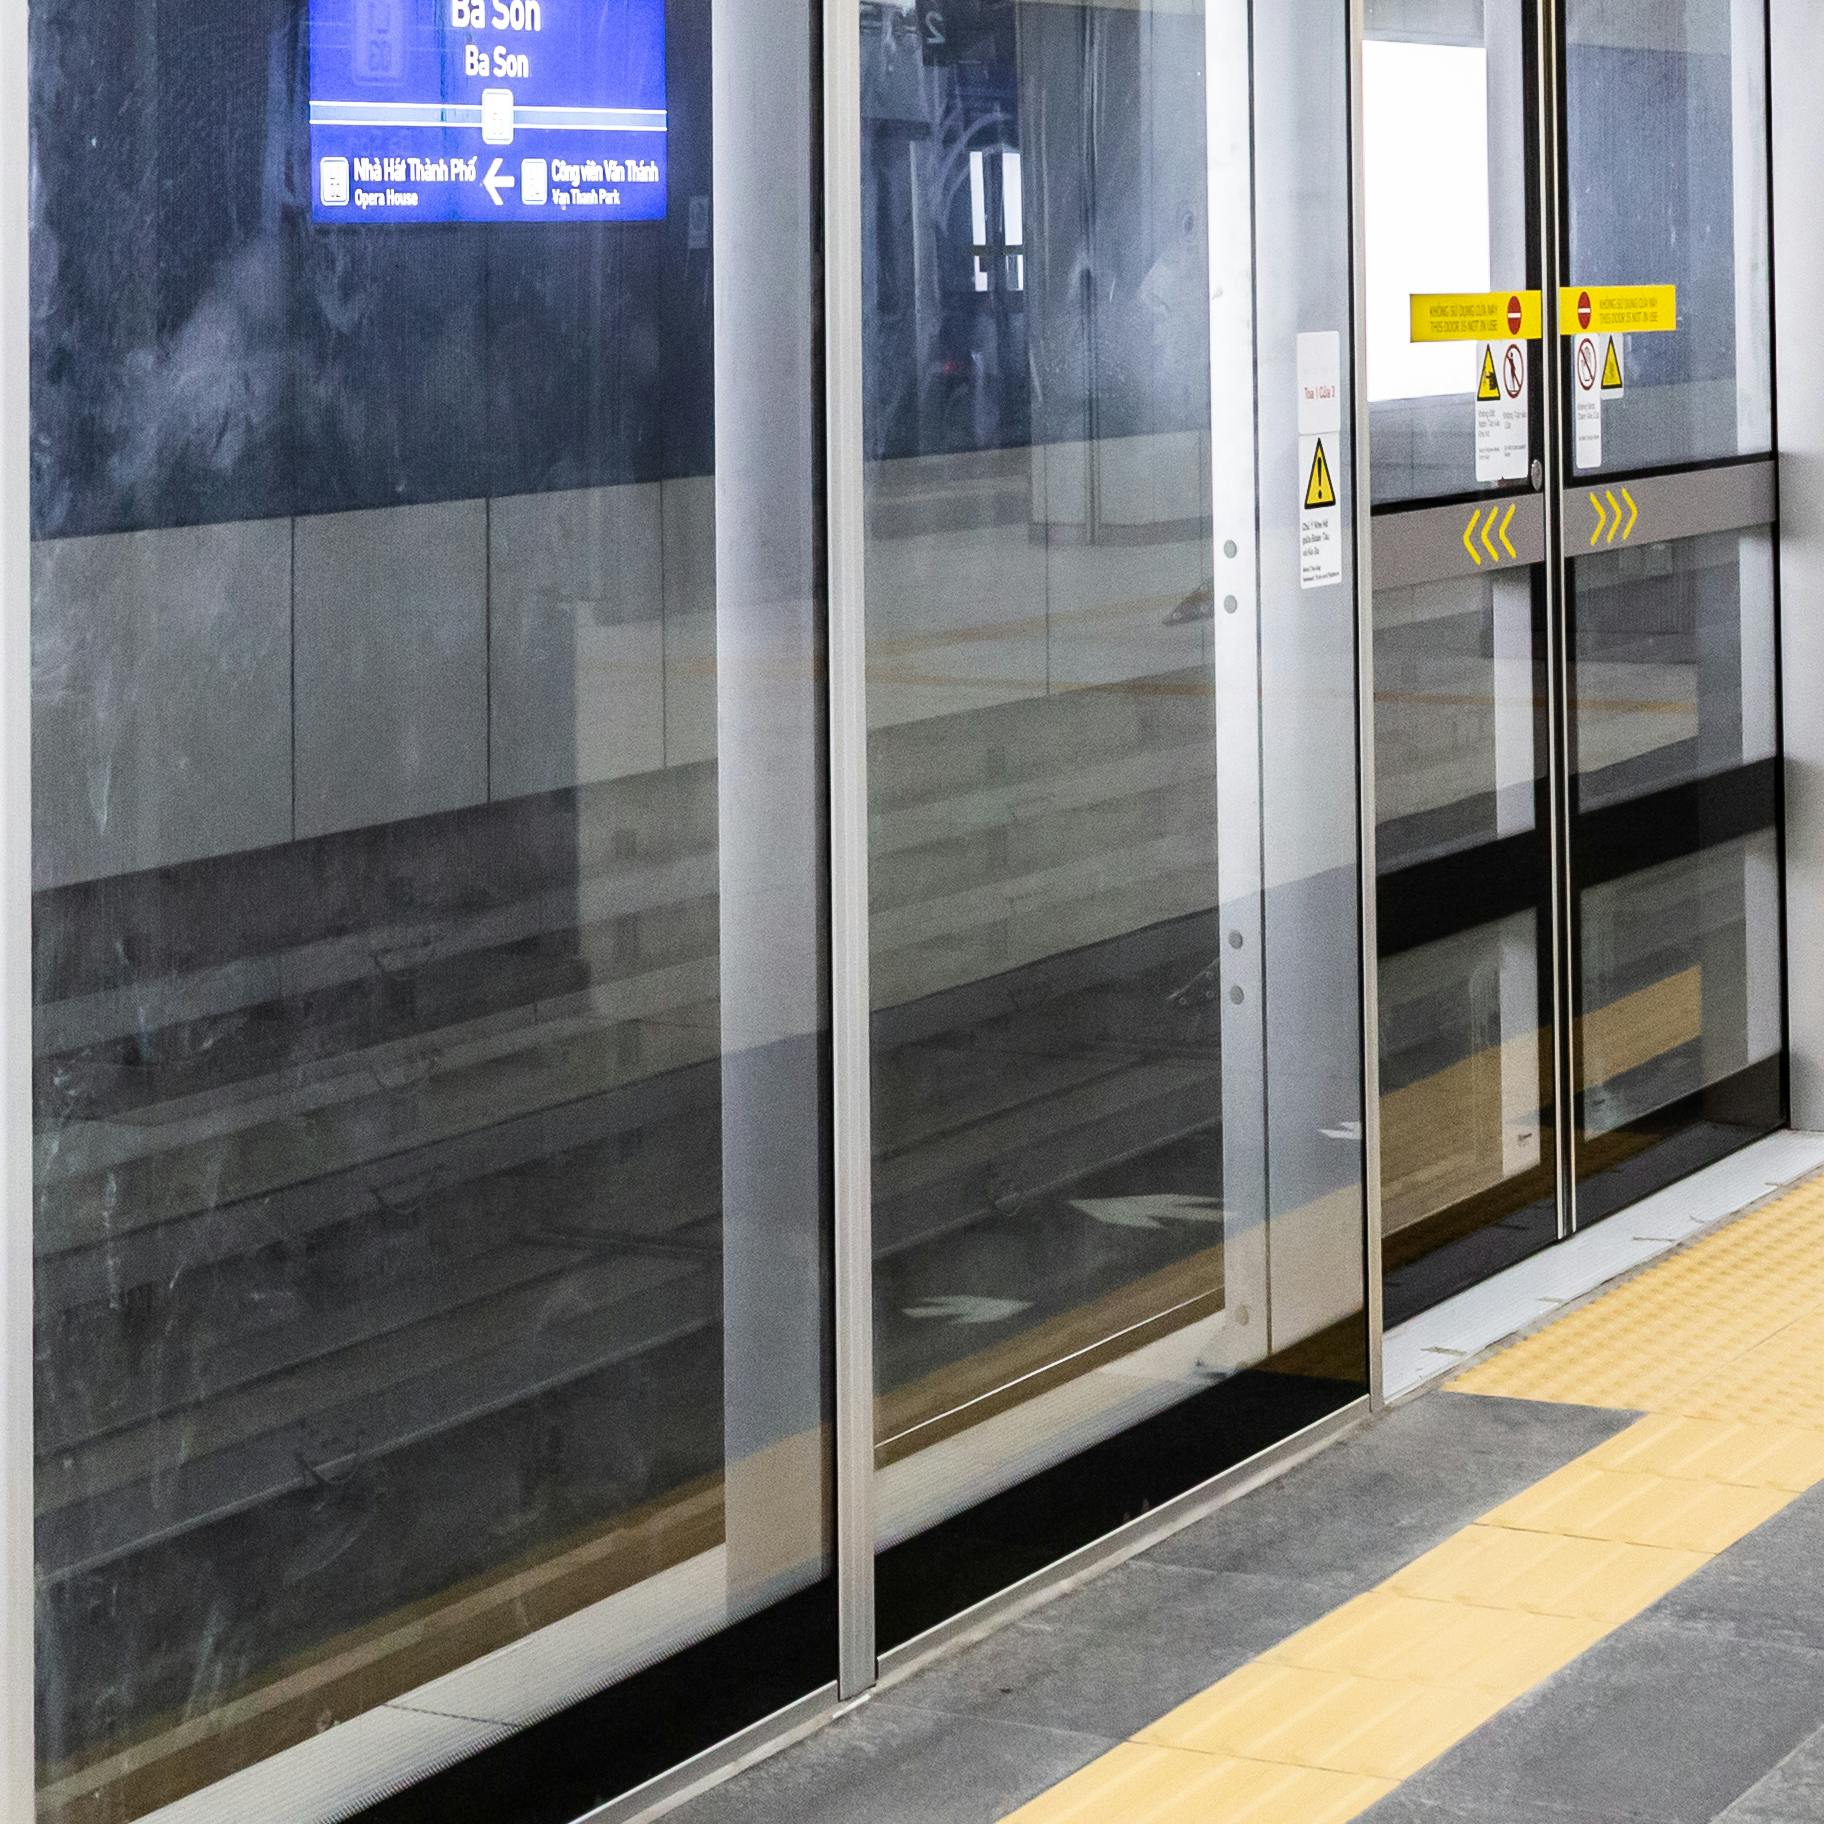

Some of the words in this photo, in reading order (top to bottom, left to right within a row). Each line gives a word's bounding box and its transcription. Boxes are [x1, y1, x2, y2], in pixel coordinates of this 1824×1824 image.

[465, 44, 490, 77] Ba
[493, 45, 529, 77] Son
[353, 157, 382, 182] Nhà
[407, 157, 449, 182] Thành
[450, 155, 478, 182] Phố
[354, 188, 385, 210] Opera
[386, 188, 418, 206] House
